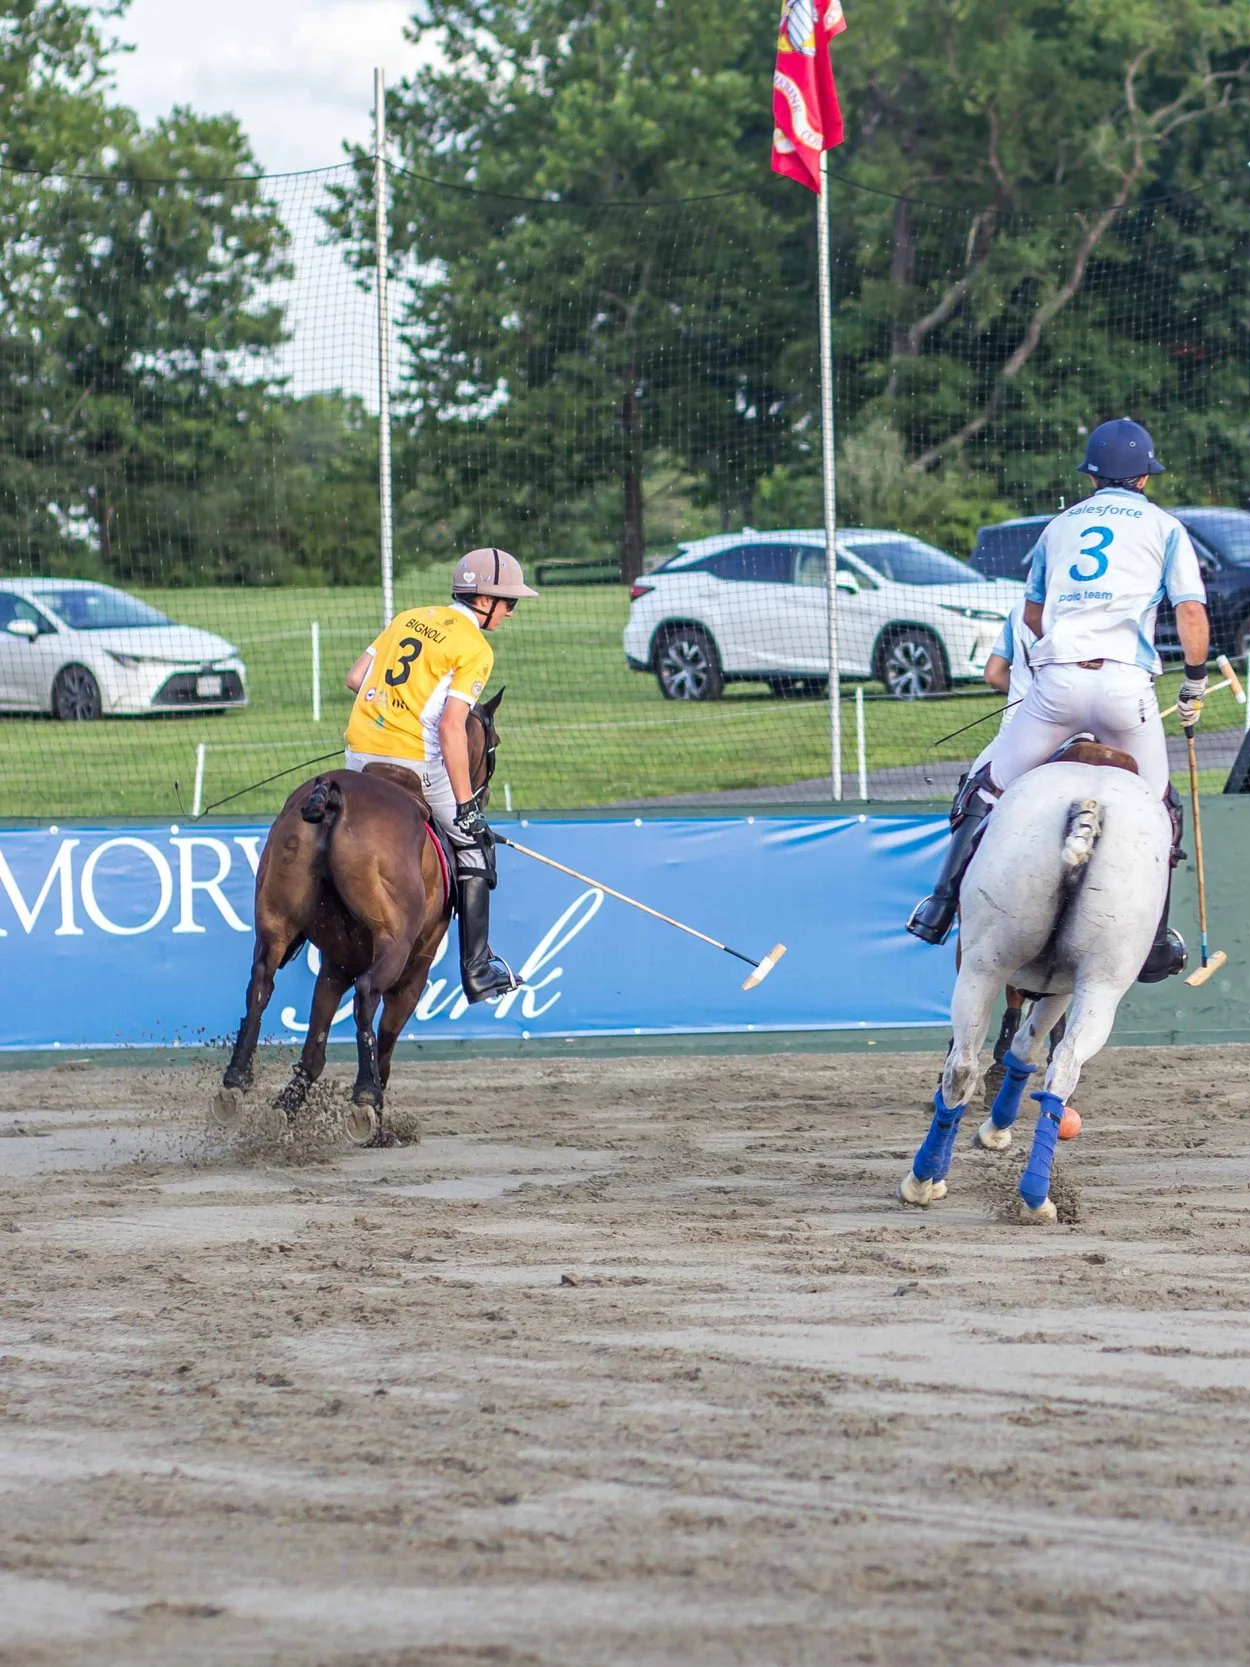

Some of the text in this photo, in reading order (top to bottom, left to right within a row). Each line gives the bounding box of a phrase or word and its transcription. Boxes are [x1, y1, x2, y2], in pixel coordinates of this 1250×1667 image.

[1067, 504, 1143, 519] salesforce
[1069, 526, 1115, 582] 3
[1084, 589, 1113, 601] team
[405, 618, 447, 644] BIGNOLI
[385, 636, 423, 687] 3
